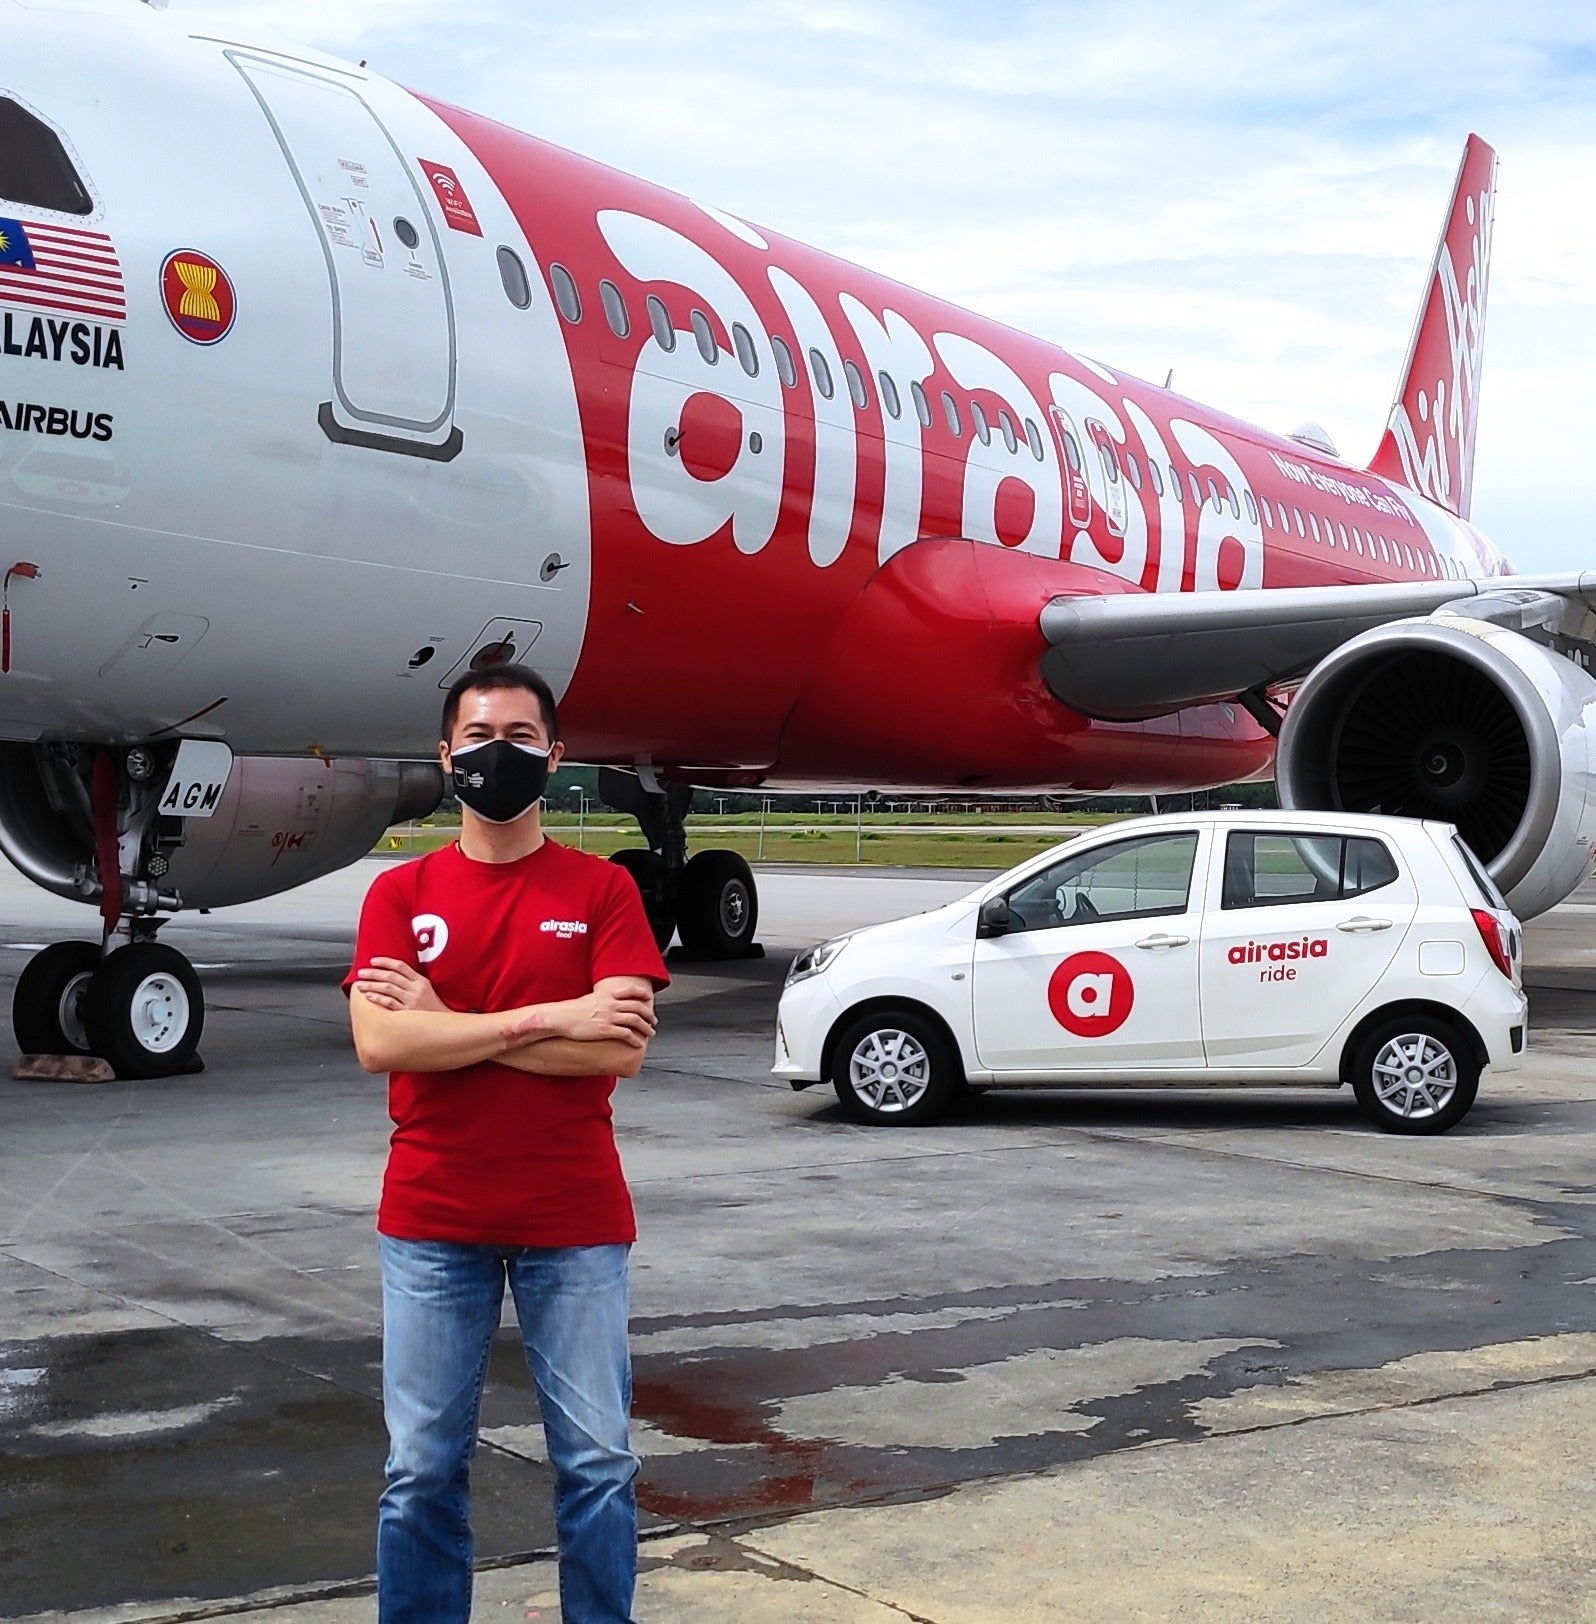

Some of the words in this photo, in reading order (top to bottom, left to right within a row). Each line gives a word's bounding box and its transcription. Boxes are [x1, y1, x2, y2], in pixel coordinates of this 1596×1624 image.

[0, 312, 125, 371] LAYSIA
[596, 198, 1264, 593] airasia
[1267, 451, 1312, 487] Now
[1301, 463, 1372, 508] Everyone
[1361, 486, 1397, 518] Can
[163, 782, 222, 810] AGM
[540, 919, 588, 934] airasia
[556, 931, 573, 939] food
[1227, 936, 1329, 965] airasia
[1259, 964, 1297, 983] ride
[1066, 972, 1114, 1019] a
